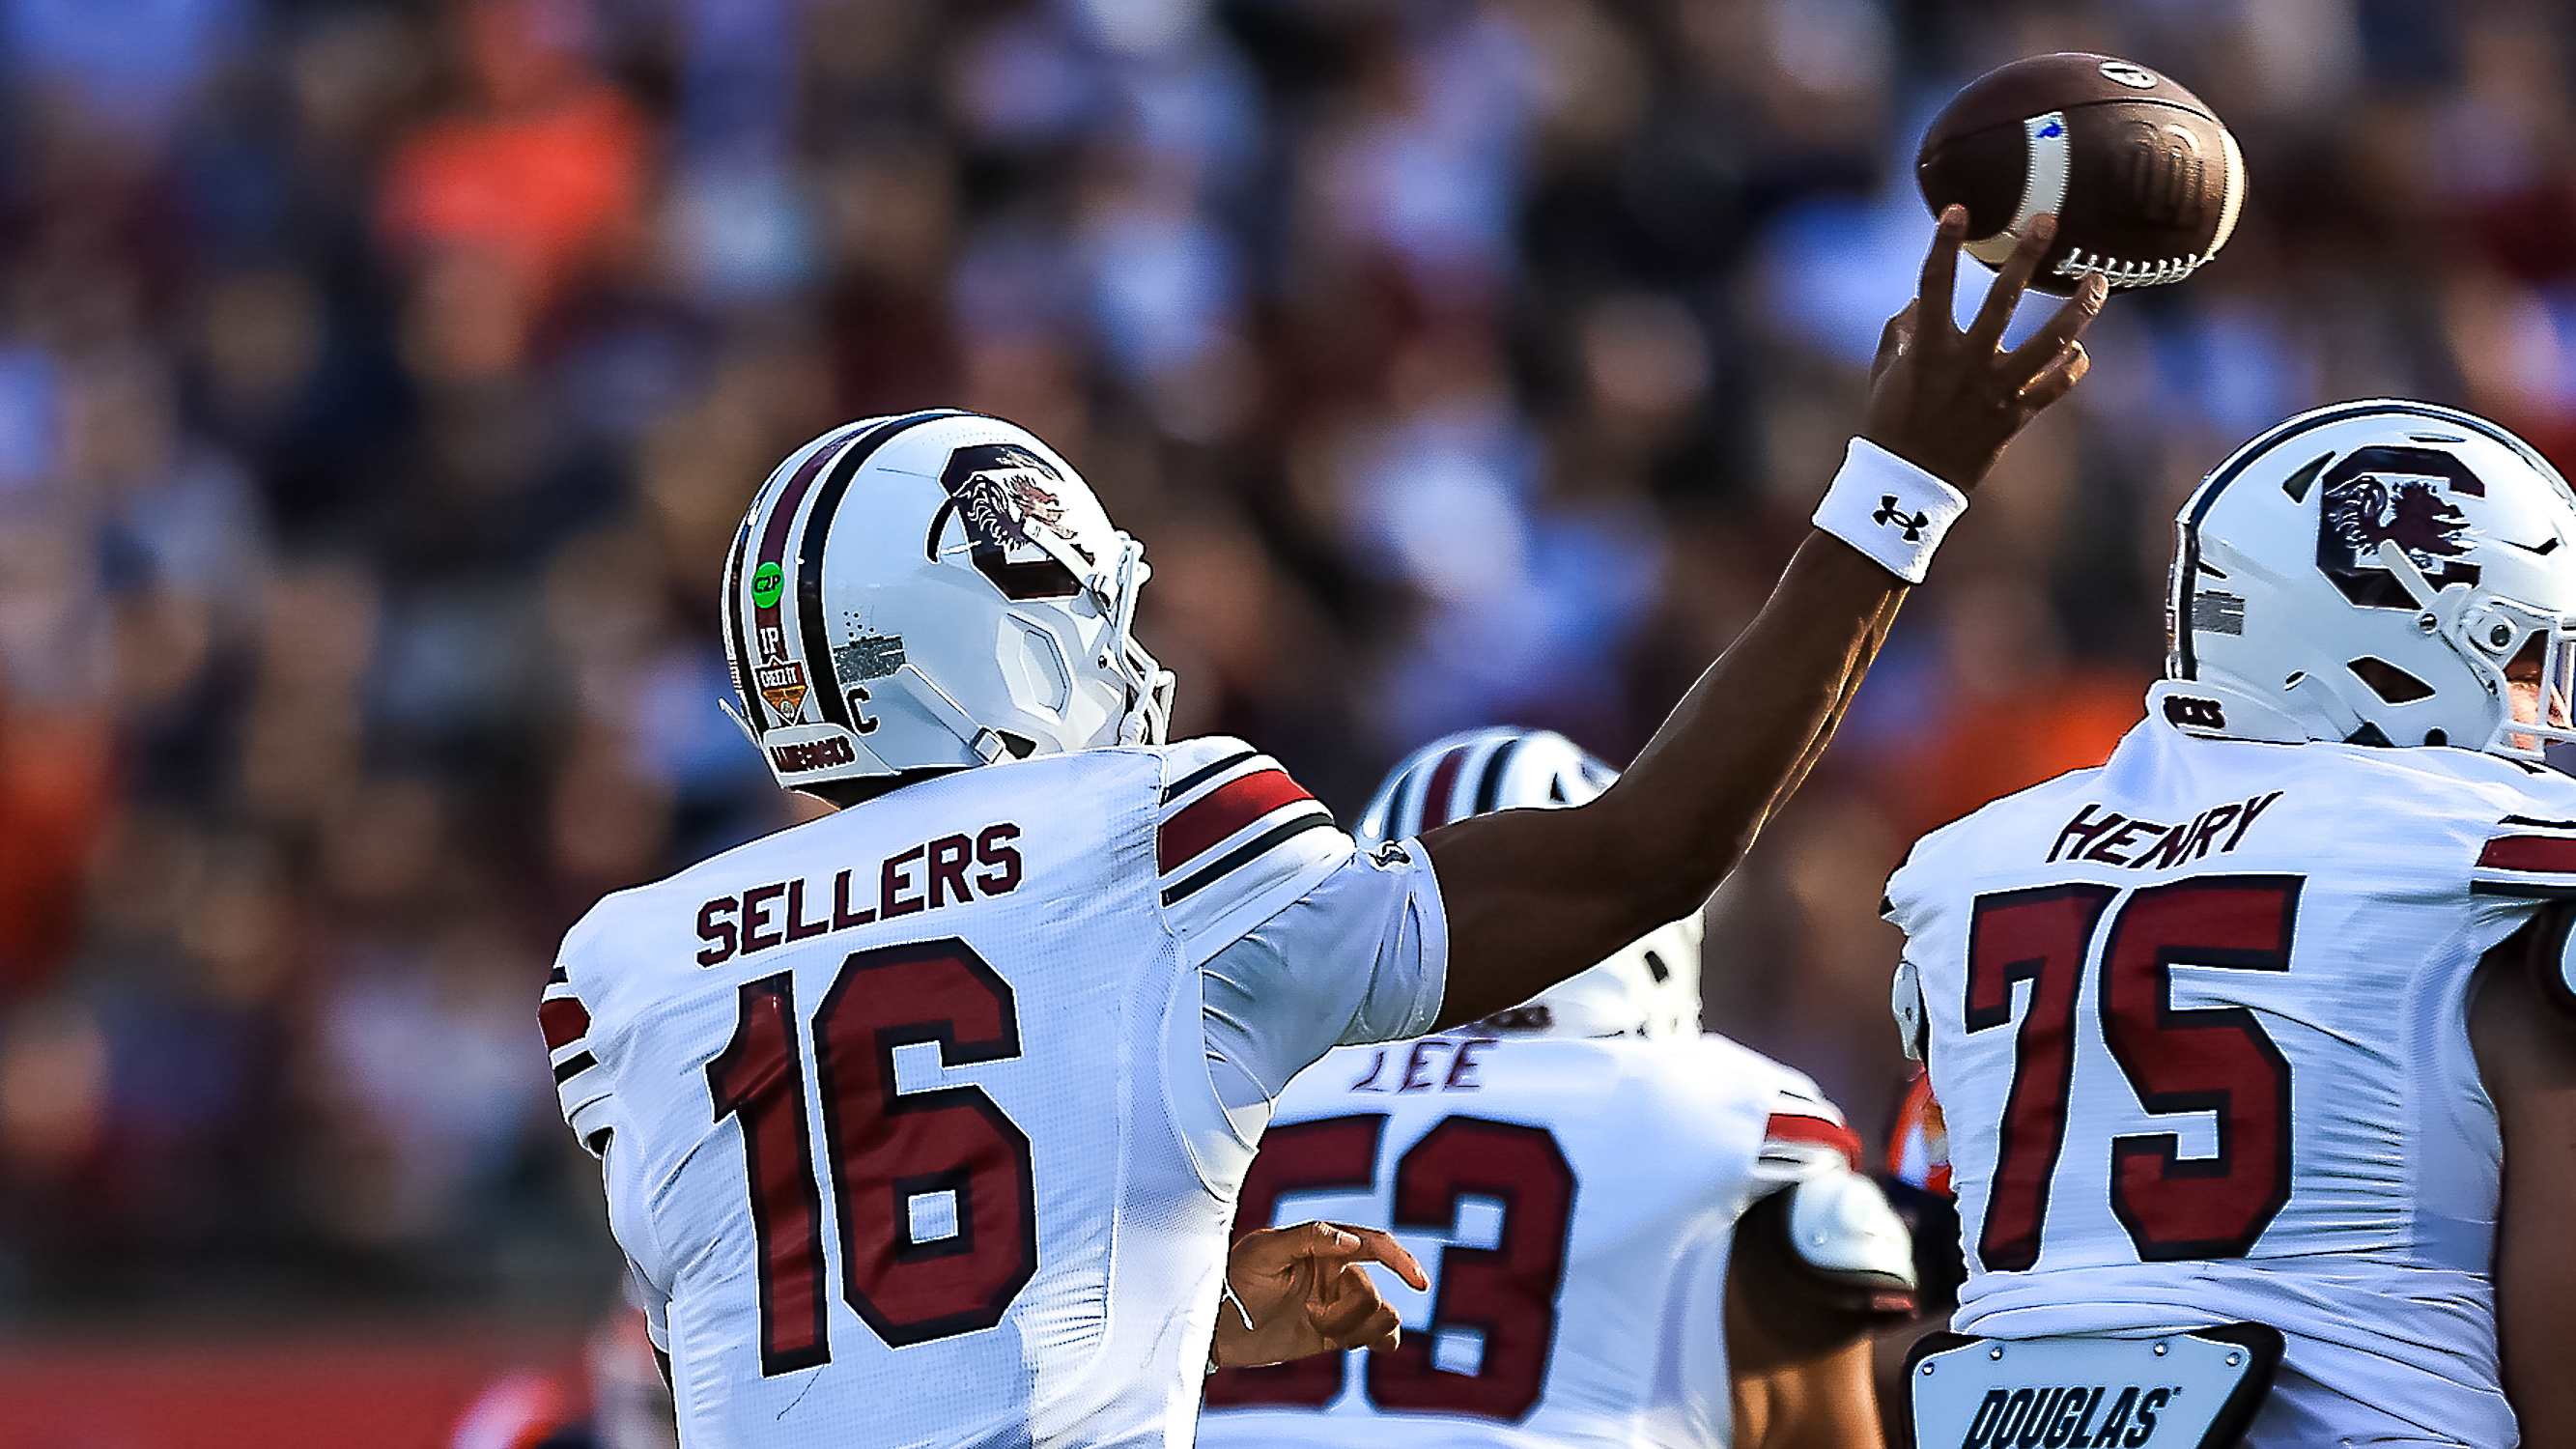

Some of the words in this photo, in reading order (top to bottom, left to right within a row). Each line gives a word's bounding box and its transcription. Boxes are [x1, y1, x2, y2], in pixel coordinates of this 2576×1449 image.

[754, 574, 781, 593] C2P
[846, 685, 879, 734] C
[2046, 790, 2283, 869] HENRY
[695, 822, 1022, 967] SELLERS
[1349, 1037, 1500, 1094] LEE
[1965, 874, 2307, 1274] 75
[705, 935, 1038, 1378] 16
[1961, 1385, 2172, 1449] DOUGLAS
